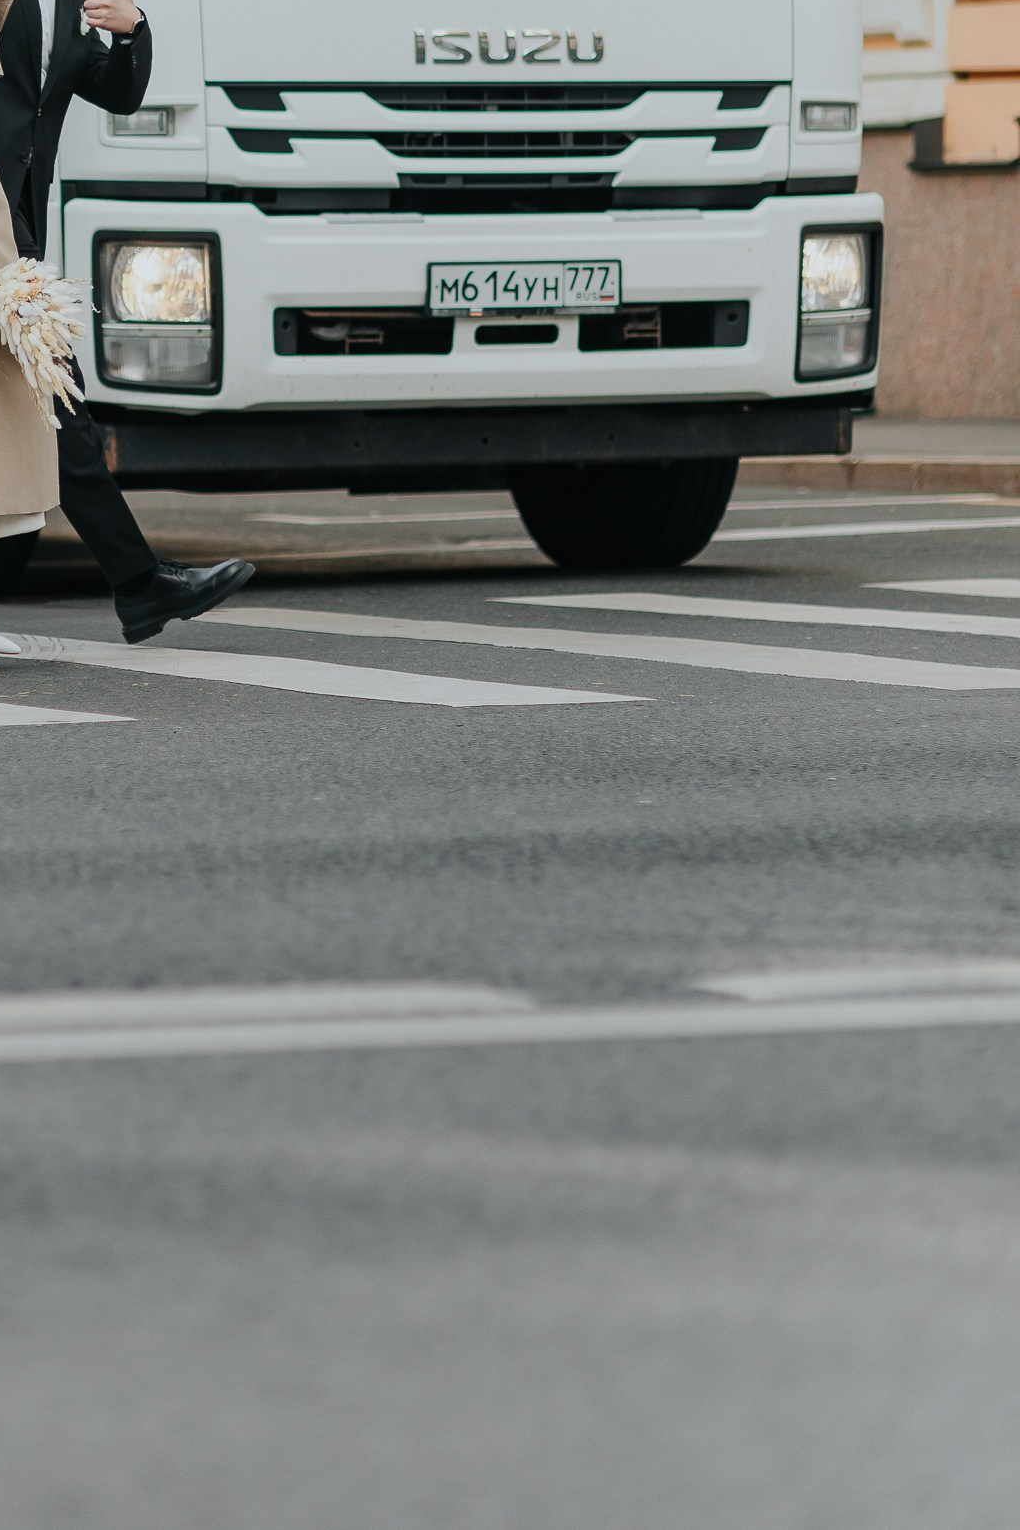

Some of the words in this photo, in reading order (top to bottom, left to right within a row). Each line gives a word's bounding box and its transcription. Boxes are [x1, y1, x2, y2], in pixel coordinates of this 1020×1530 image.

[413, 29, 604, 64] ISUZU
[440, 270, 559, 303] М614УН
[566, 267, 610, 291] 777
[576, 292, 598, 301] RUS
